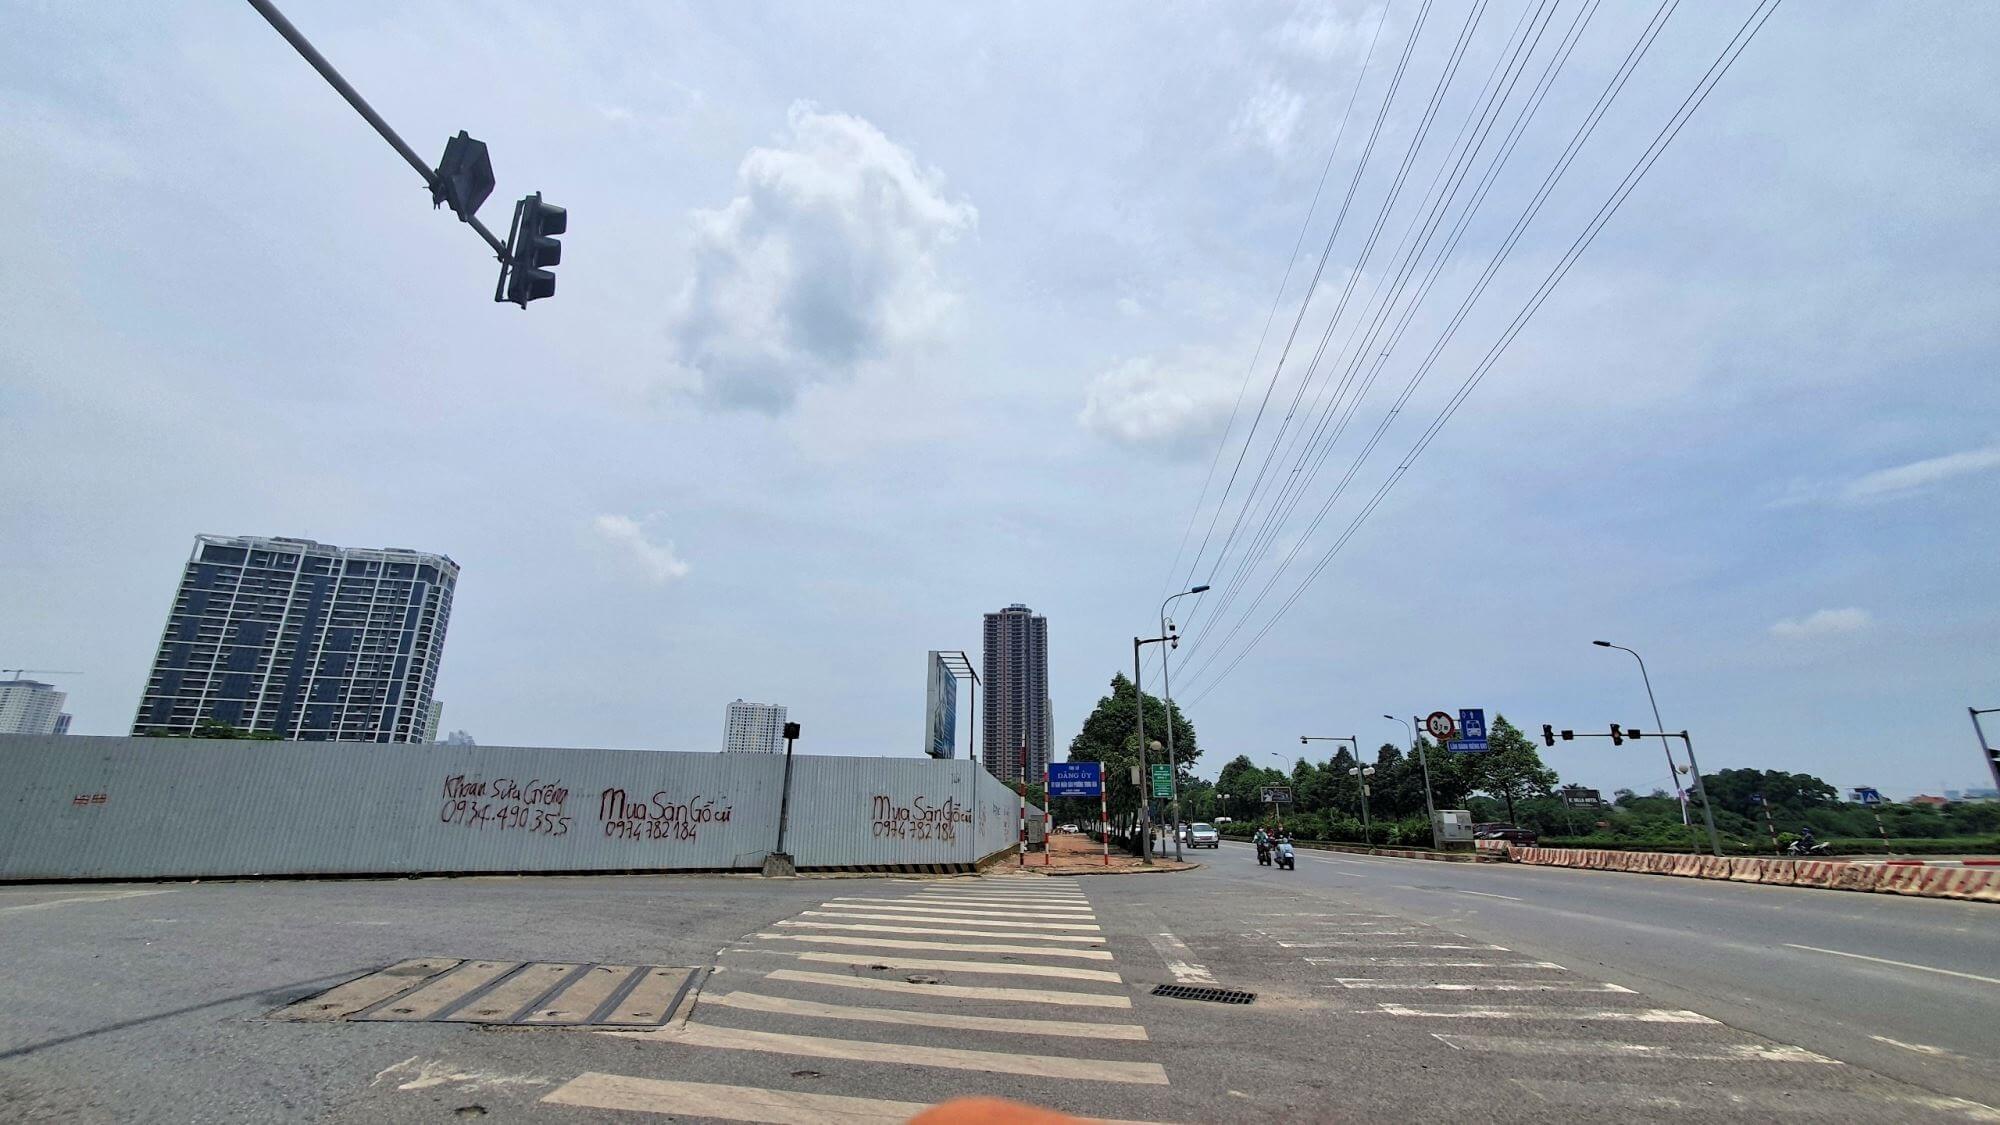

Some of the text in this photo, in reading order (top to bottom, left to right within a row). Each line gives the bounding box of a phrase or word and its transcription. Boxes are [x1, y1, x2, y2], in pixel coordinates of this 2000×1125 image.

[1057, 769, 1092, 779] ĐẢNG ỦY
[443, 775, 486, 799] Khoan
[600, 788, 646, 820] Mua
[690, 796, 714, 822] Gỗ
[873, 796, 910, 821] Mua
